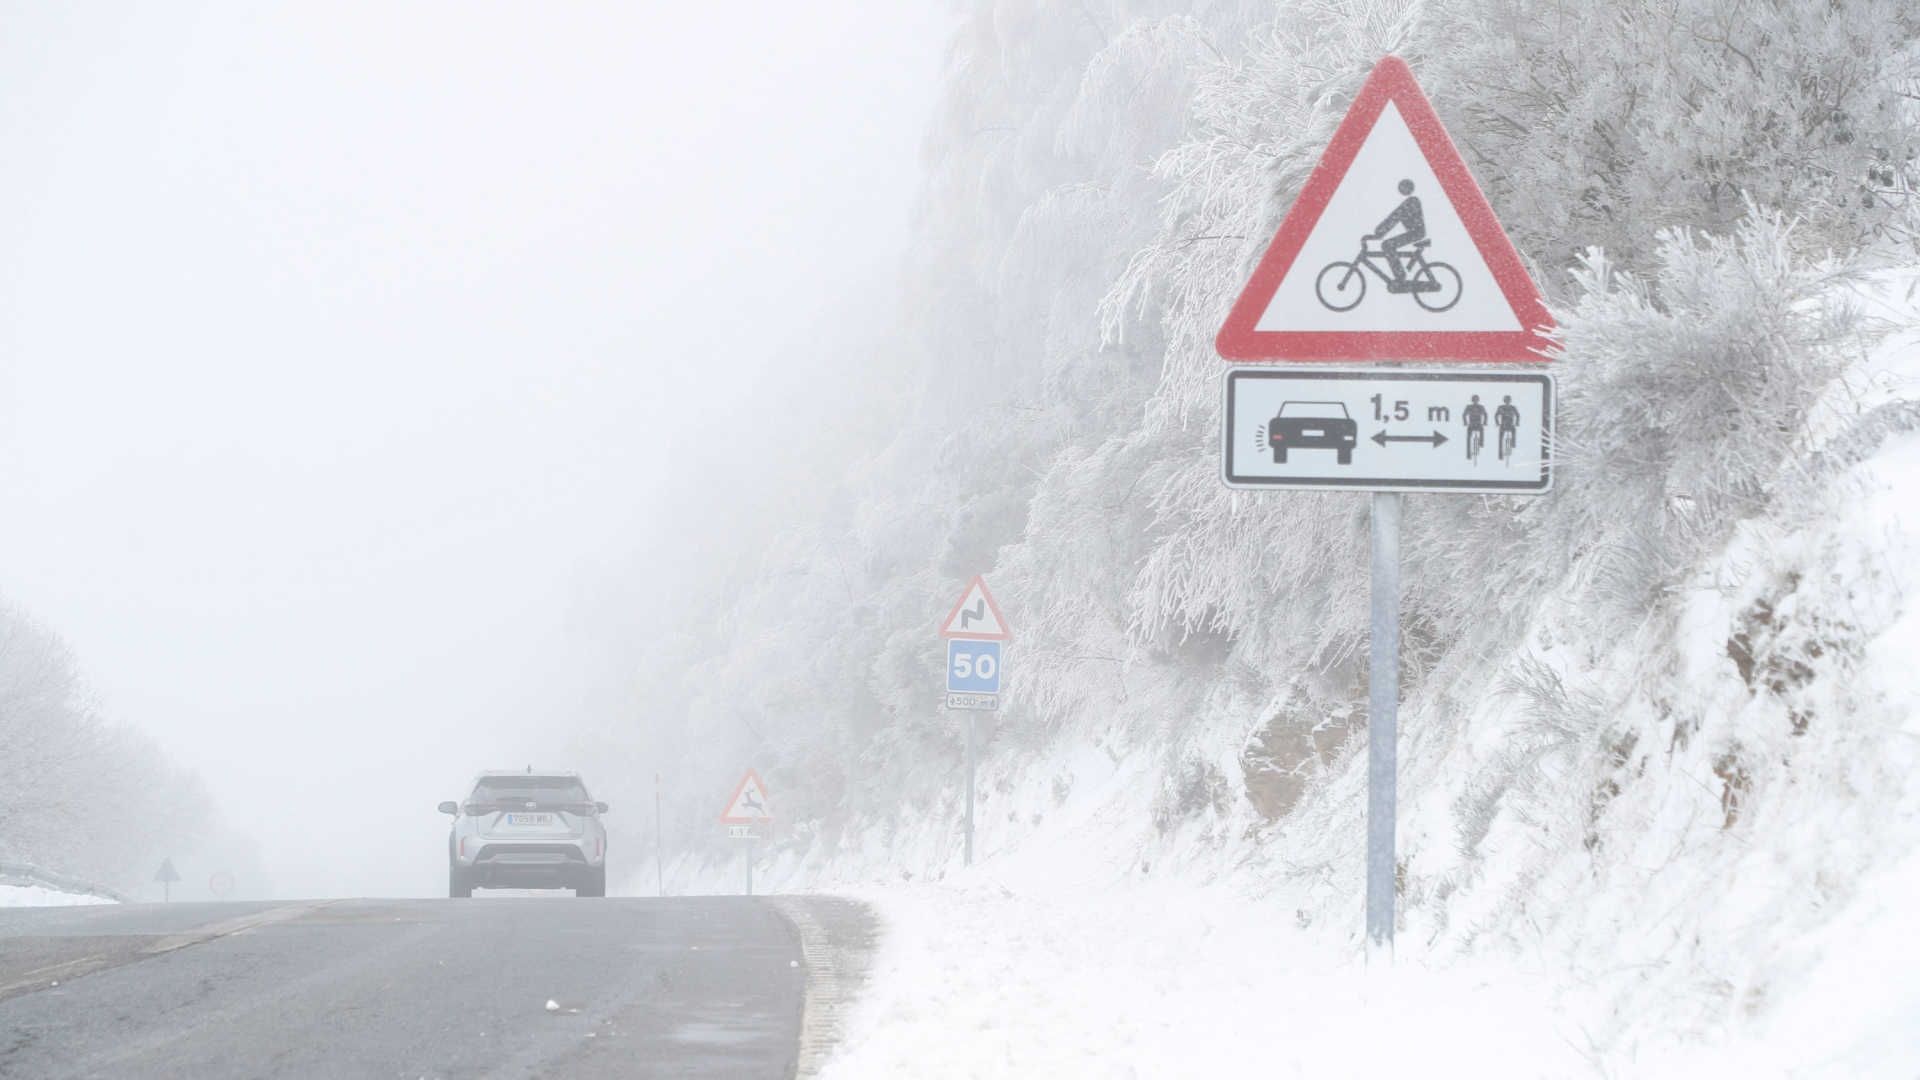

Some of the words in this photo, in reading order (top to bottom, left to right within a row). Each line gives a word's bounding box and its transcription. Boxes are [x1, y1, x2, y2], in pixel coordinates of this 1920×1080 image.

[1370, 393, 1409, 423] 1,5
[1428, 406, 1449, 422] m
[954, 653, 995, 679] 50
